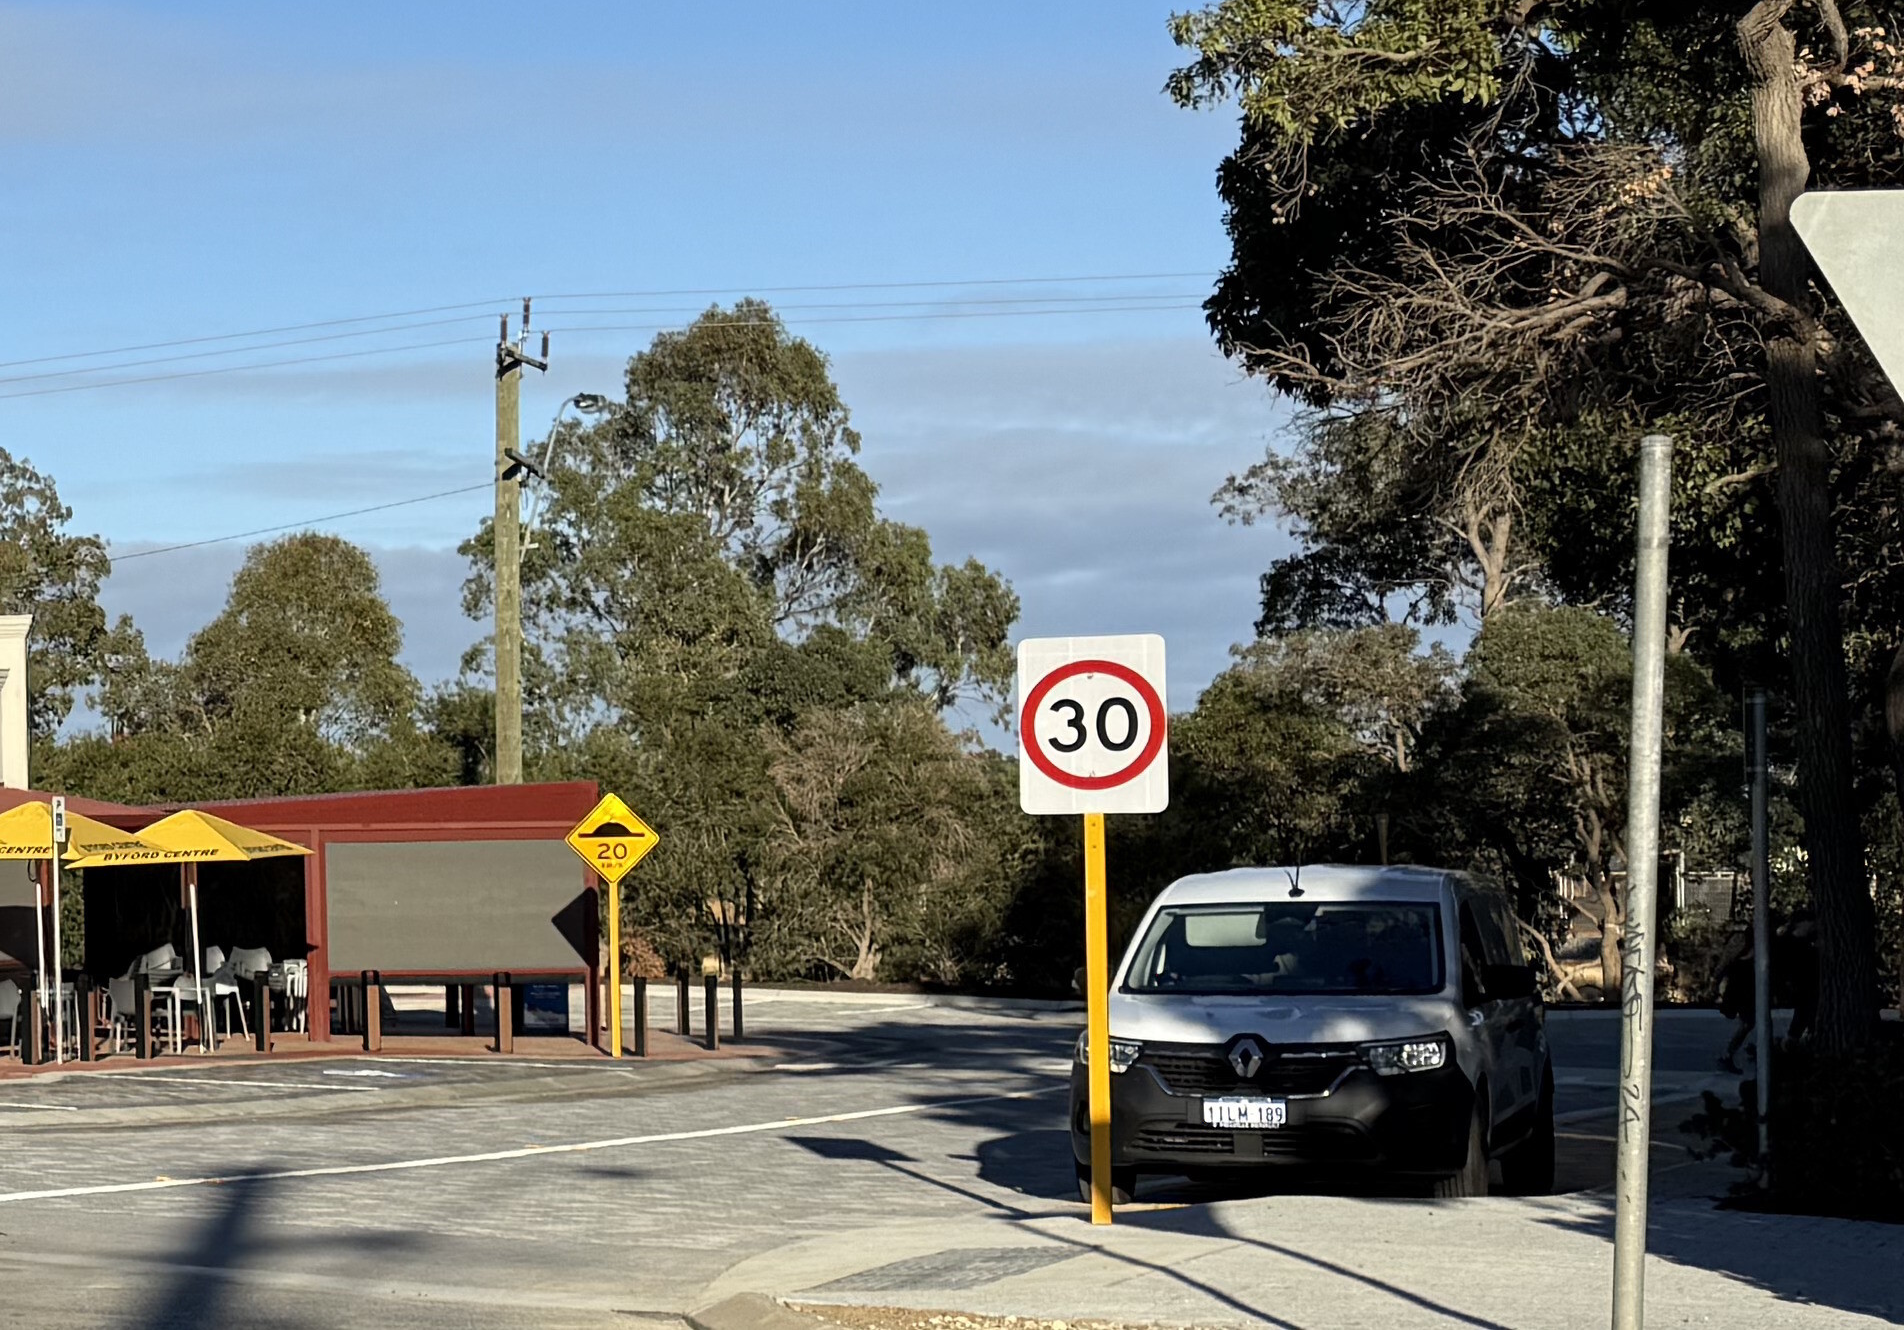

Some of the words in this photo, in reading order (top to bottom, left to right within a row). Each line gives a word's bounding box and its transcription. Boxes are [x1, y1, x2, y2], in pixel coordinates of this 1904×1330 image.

[1048, 696, 1139, 753] 30
[103, 850, 161, 862] BYFORD
[163, 848, 220, 860] CENTRE
[597, 843, 628, 860] 20
